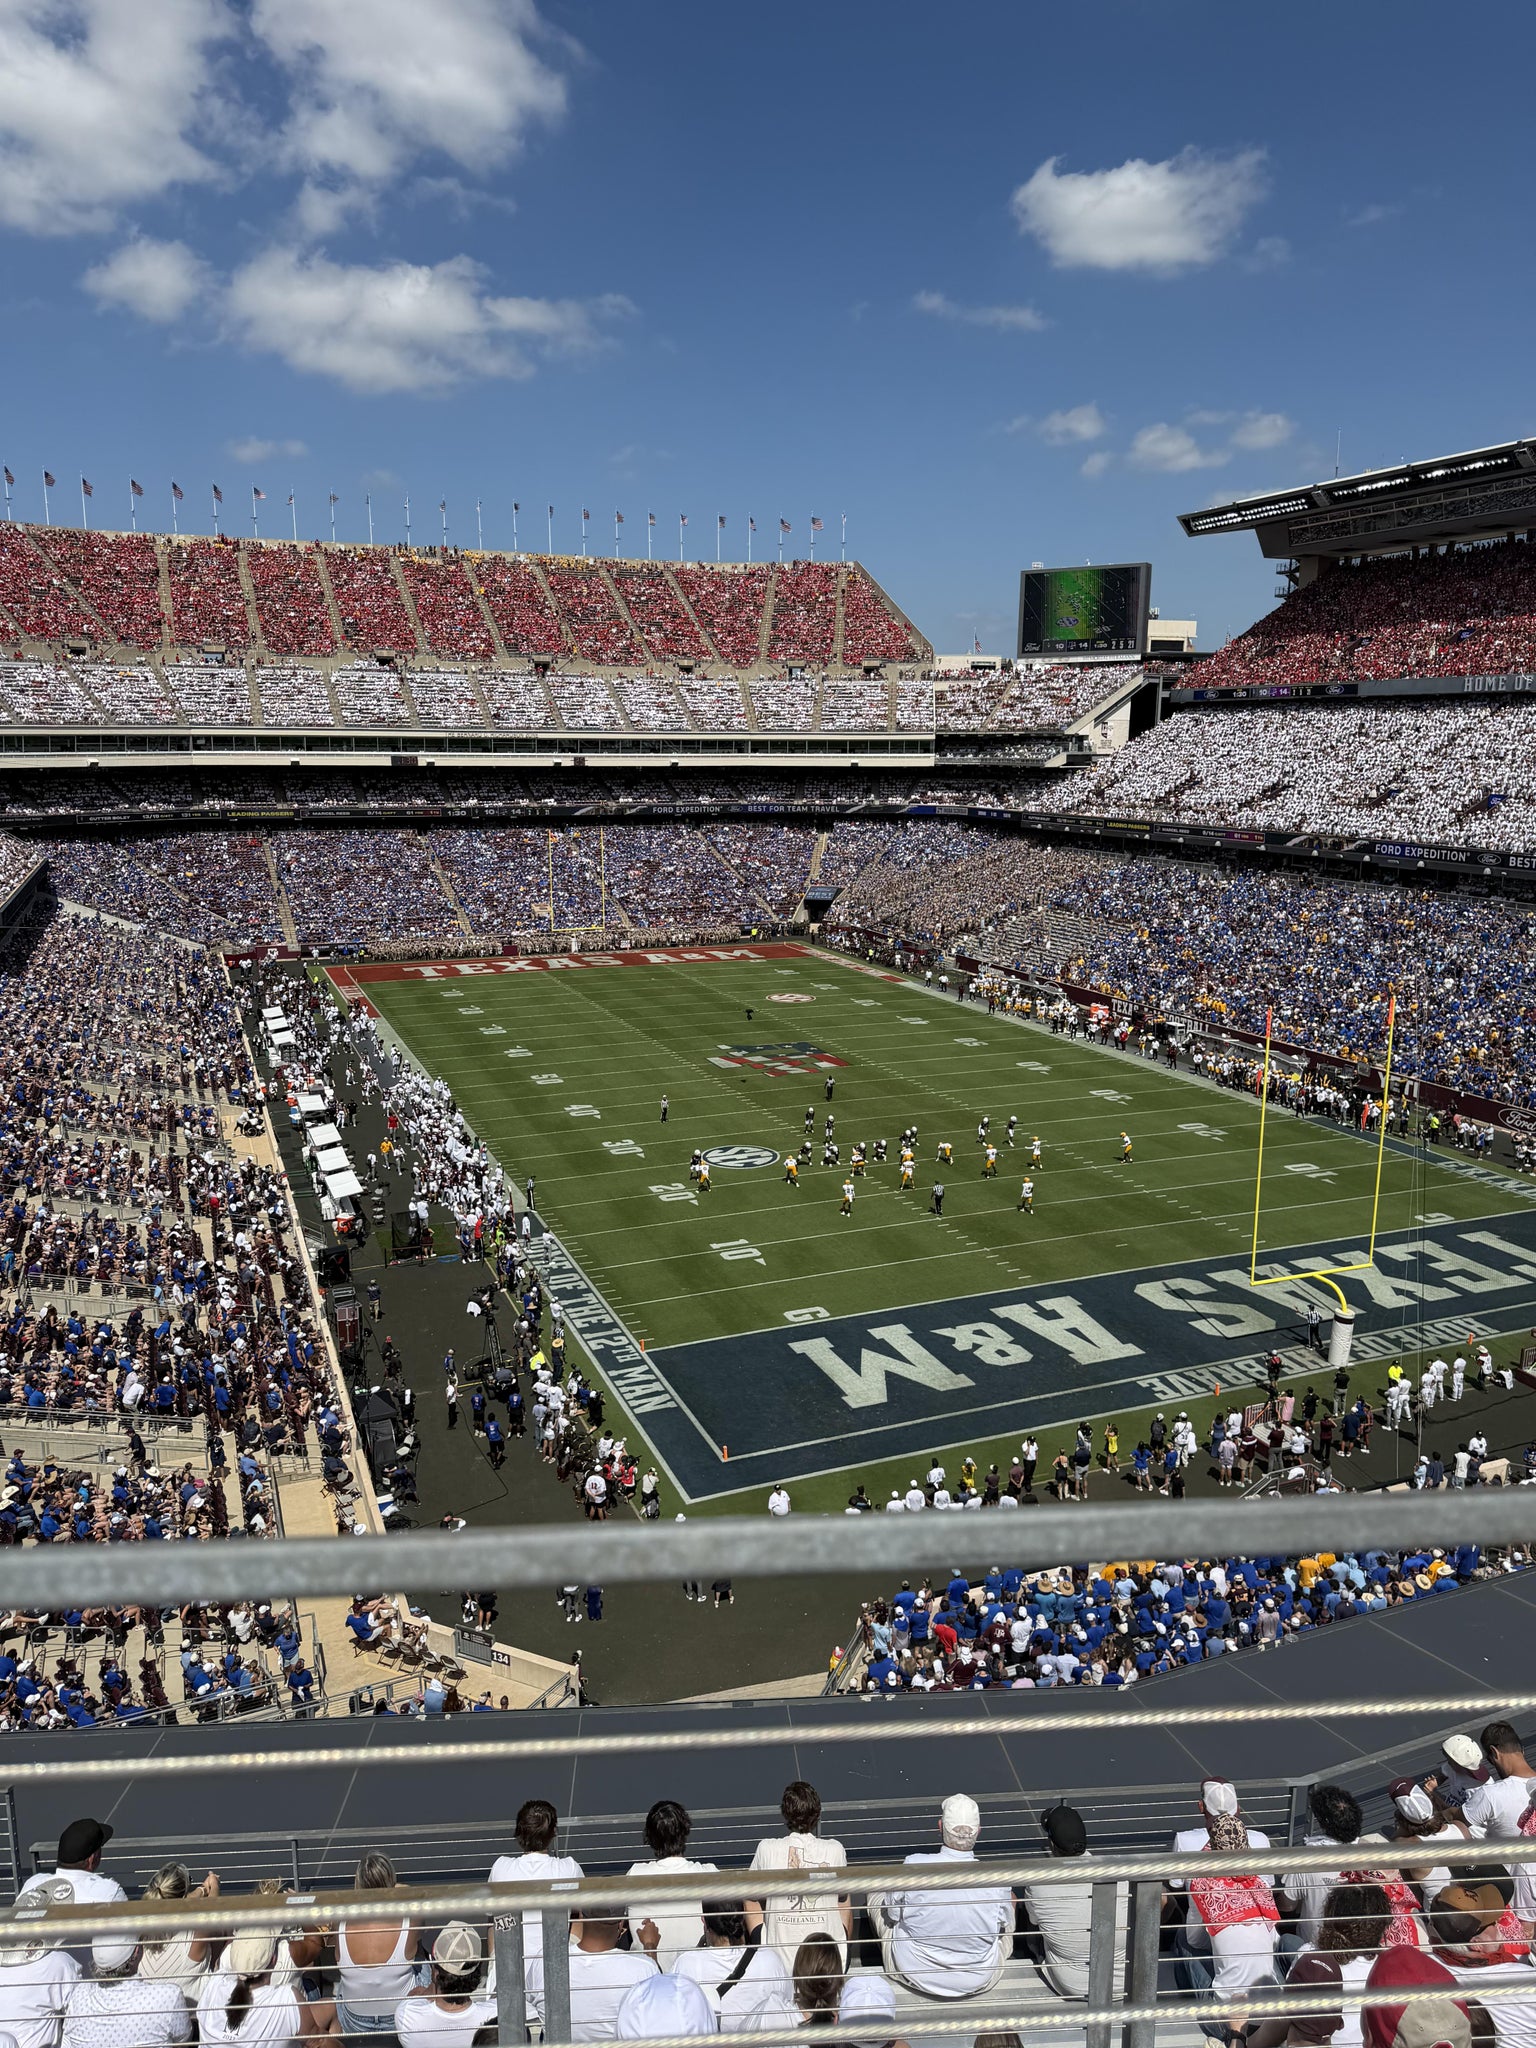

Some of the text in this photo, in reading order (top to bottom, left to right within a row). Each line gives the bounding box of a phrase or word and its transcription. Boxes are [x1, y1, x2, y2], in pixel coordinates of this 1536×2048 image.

[1024, 642, 1041, 652] Ford
[1111, 640, 1116, 649] 2
[1463, 674, 1535, 692] HOME OF
[1375, 843, 1402, 855] FORD
[1508, 856, 1536, 868] BEST
[403, 949, 765, 977] TEXAS A&M
[529, 1073, 565, 1085] 50
[1377, 1071, 1420, 1099] YETI
[563, 1104, 601, 1117] 40
[1176, 1122, 1229, 1137] 20
[1505, 1110, 1536, 1132] Ford
[601, 1138, 644, 1155] 30
[1283, 1162, 1339, 1179] 10
[648, 1182, 697, 1202] 20
[709, 1238, 762, 1261] 10
[548, 1272, 588, 1291] OF
[560, 1292, 614, 1329] THE
[783, 1306, 830, 1322] G
[1387, 1317, 1501, 1350] HOME
[582, 1327, 642, 1363] 12TH
[787, 1295, 1147, 1409] A&M
[1136, 1358, 1269, 1400] BRAVE
[607, 1364, 678, 1415] MAN
[492, 1651, 509, 1665] 134
